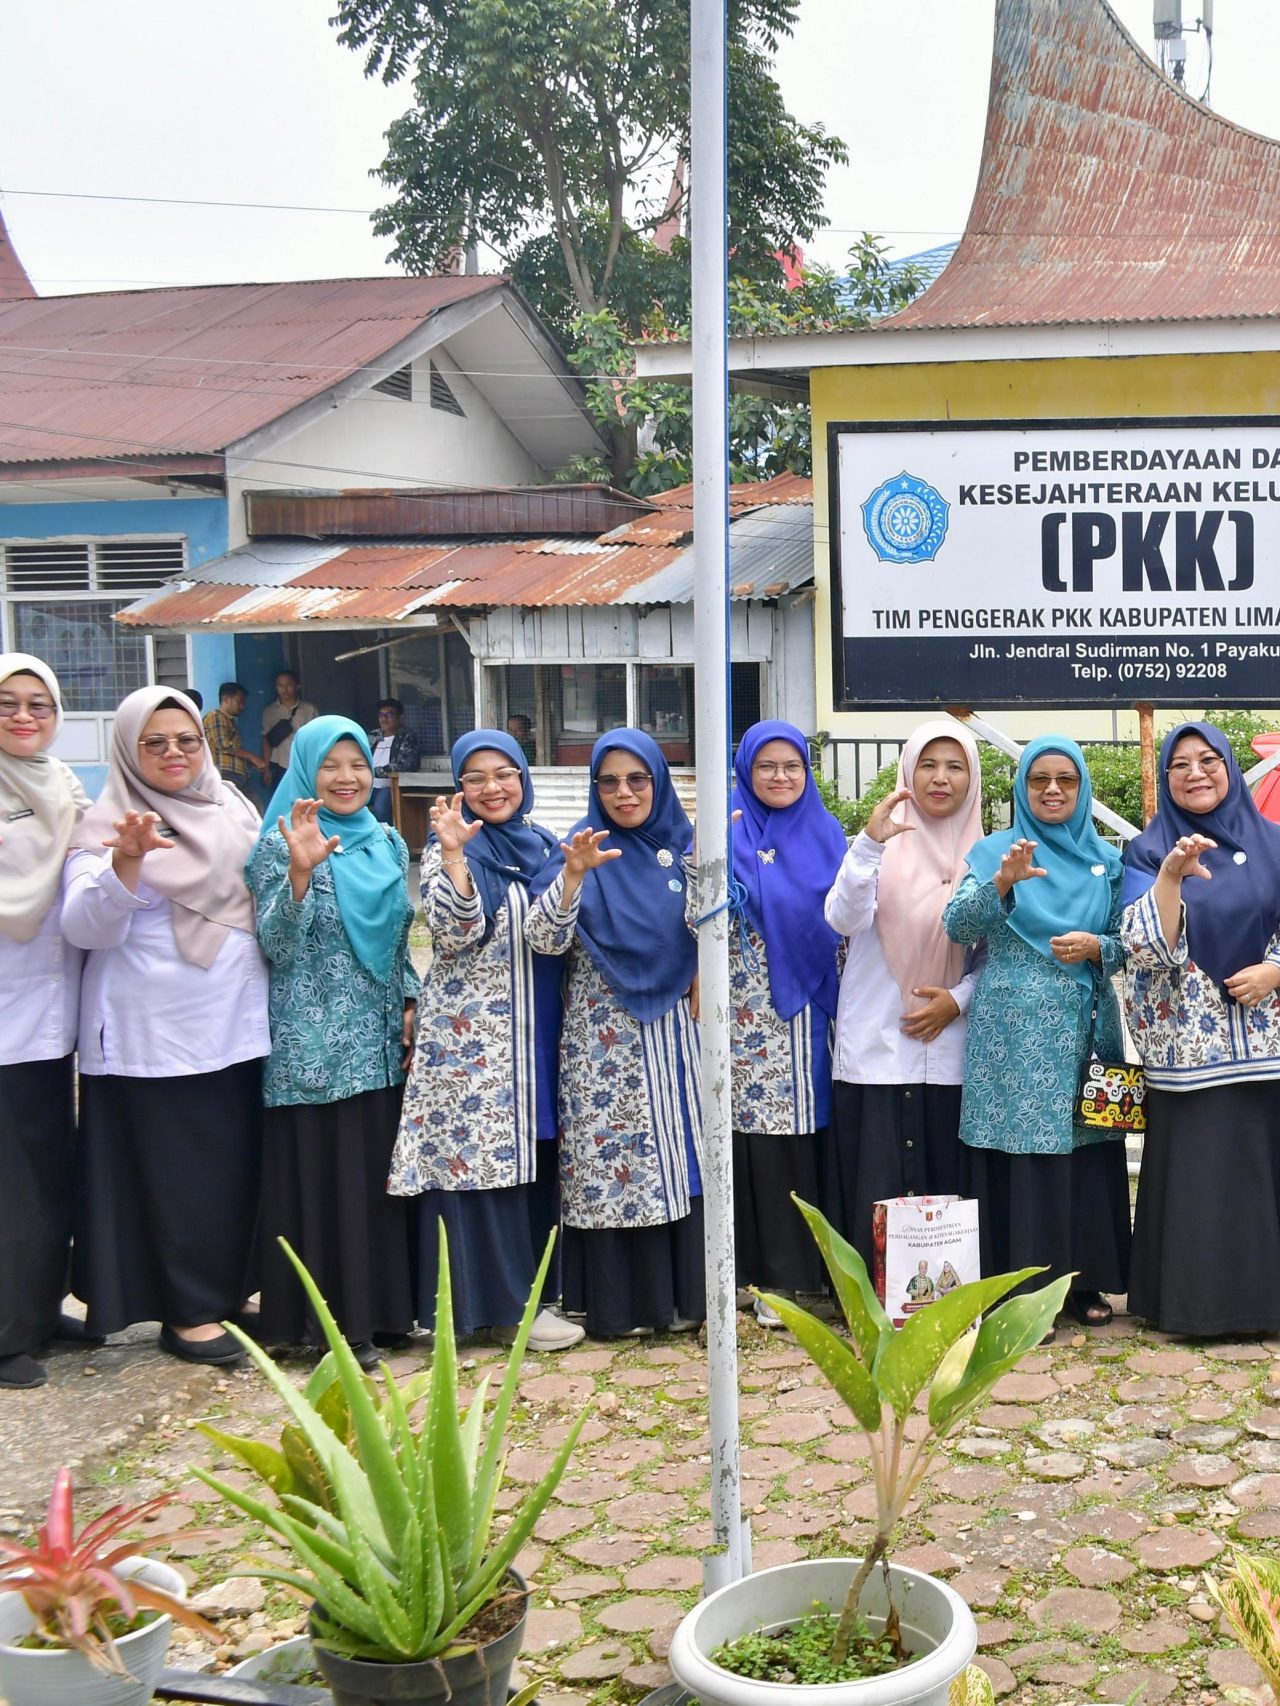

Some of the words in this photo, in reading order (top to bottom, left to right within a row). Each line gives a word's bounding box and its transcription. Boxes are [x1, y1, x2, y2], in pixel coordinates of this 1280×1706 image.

[1014, 448, 1241, 472] PEMBERDAYAAN
[959, 482, 1202, 506] KESEJAHTERAAN
[1041, 510, 1255, 593] (PKK)
[872, 609, 911, 629] TIM
[918, 608, 1045, 629] PENGGERAK
[1052, 608, 1093, 628] PKK
[1099, 607, 1227, 628] KABUPATEN
[969, 643, 1001, 659] Jln.
[1005, 642, 1070, 660] Jendral
[1075, 642, 1160, 658] Sudirman
[1165, 642, 1195, 658] No.
[1200, 642, 1208, 658] 1
[1070, 663, 1113, 682] Telp.
[1117, 662, 1171, 682] (0752)
[1175, 662, 1228, 679] 92208
[908, 1240, 943, 1248] KABUPATEN
[944, 1237, 962, 1246] AGAM
